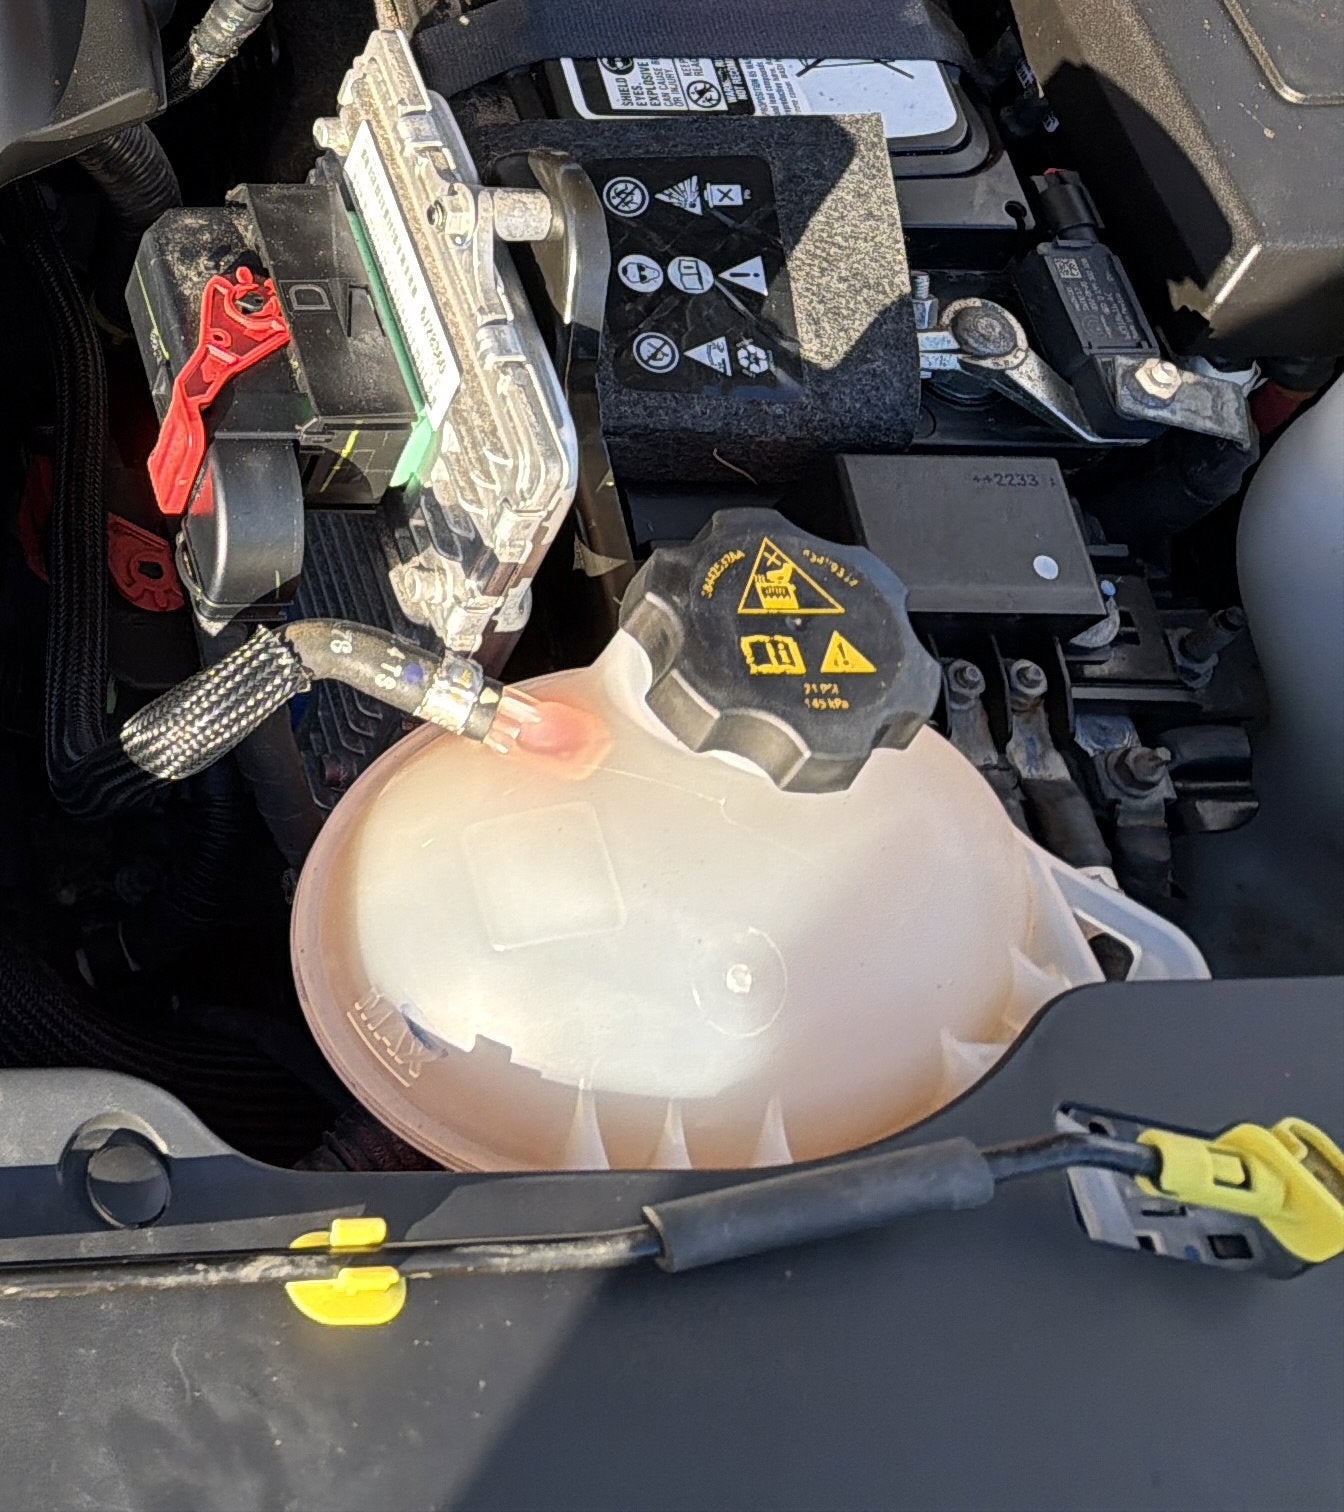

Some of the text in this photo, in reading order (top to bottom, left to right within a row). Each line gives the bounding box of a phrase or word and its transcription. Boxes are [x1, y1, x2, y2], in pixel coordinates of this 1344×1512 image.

[678, 58, 692, 76] KEEP
[637, 62, 661, 106] EXPLOSIVE
[653, 68, 668, 90] CAUSE
[615, 78, 634, 106] SHIELD
[631, 82, 648, 106] EYES.
[661, 92, 674, 107] CAN
[673, 96, 684, 107] OR
[734, 86, 749, 101] NOT
